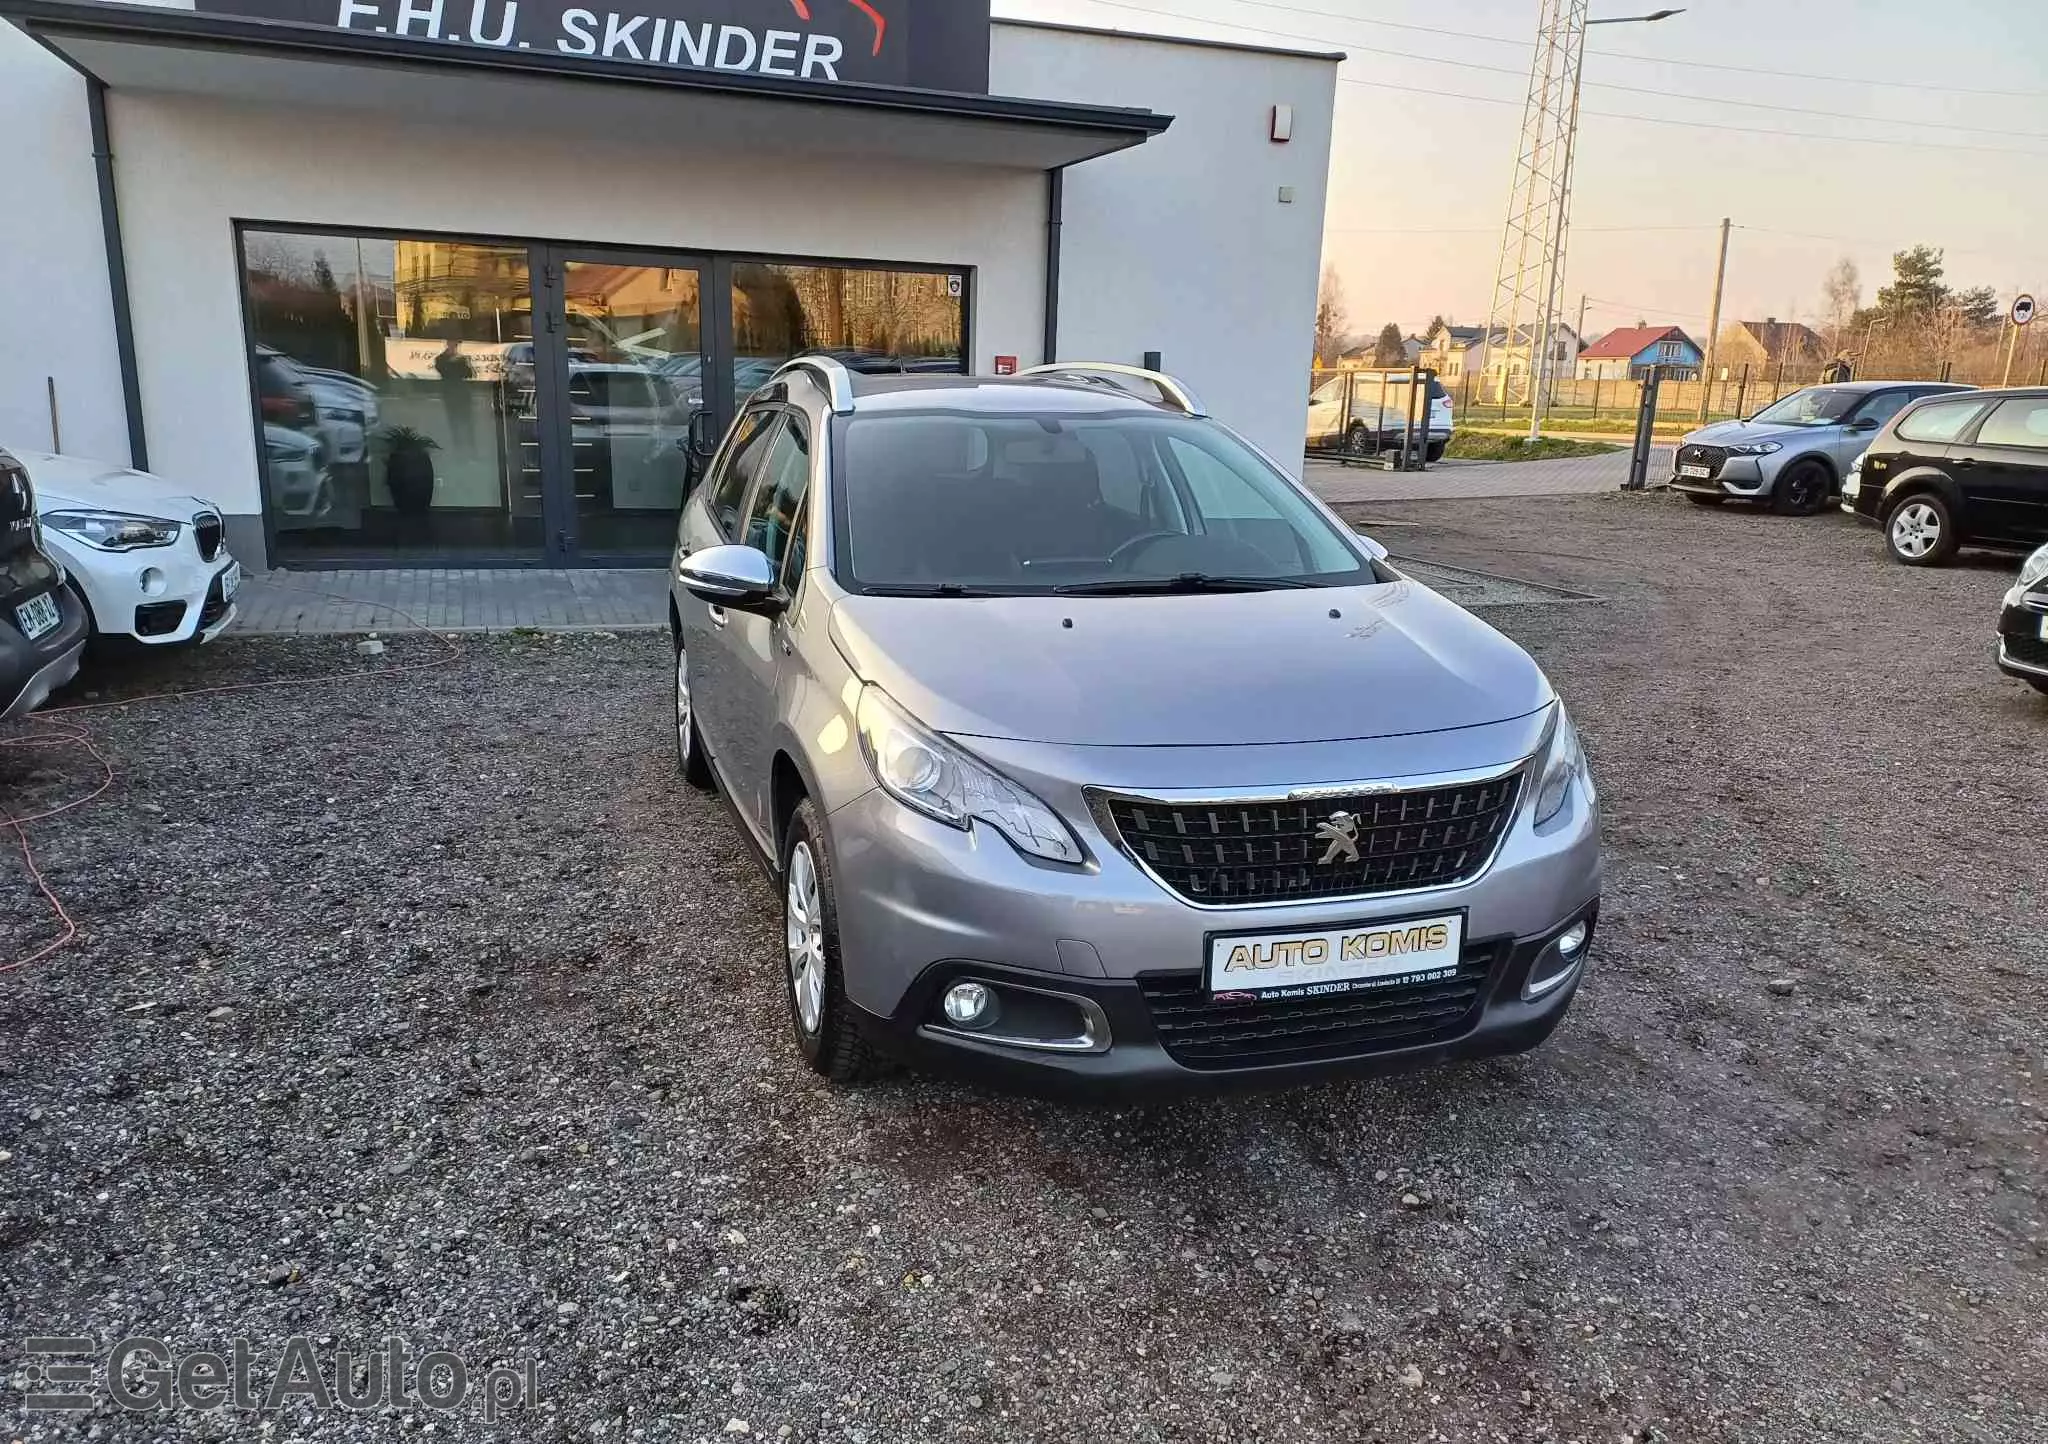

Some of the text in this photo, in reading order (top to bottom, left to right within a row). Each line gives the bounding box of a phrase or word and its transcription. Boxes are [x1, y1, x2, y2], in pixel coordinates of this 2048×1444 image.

[556, 8, 843, 81] SKINDER
[1224, 924, 1449, 972] AUTO KOMIS
[1261, 991, 1279, 999] Auto
[1281, 987, 1305, 998] Komis
[1306, 982, 1351, 996] SKINDER
